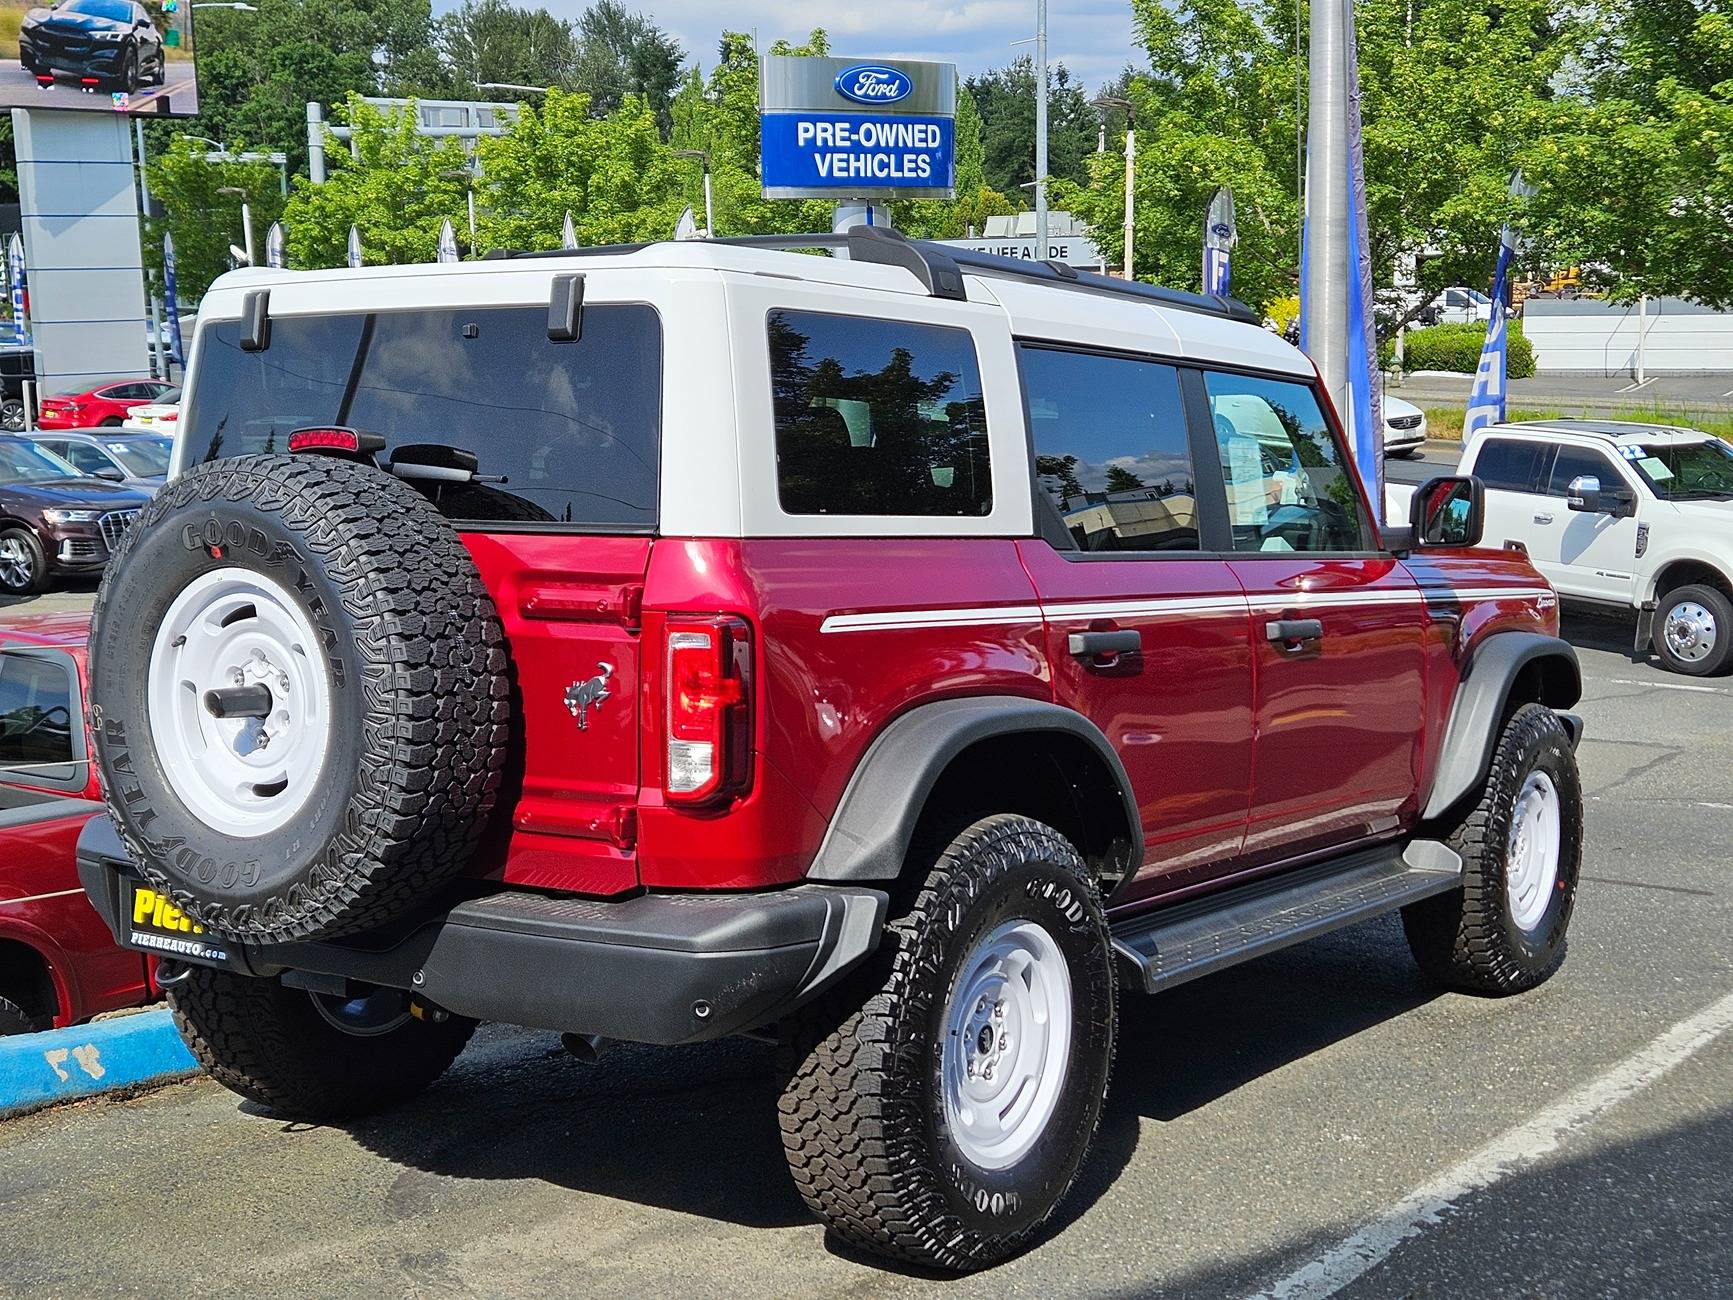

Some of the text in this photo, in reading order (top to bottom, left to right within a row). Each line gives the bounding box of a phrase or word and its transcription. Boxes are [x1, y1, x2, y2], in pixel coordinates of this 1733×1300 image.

[853, 71, 899, 98] Ford
[797, 121, 941, 148] PRE-OWNED
[814, 152, 931, 178] VEHICLES
[1021, 246, 1031, 259] A
[1617, 445, 1648, 460] 22
